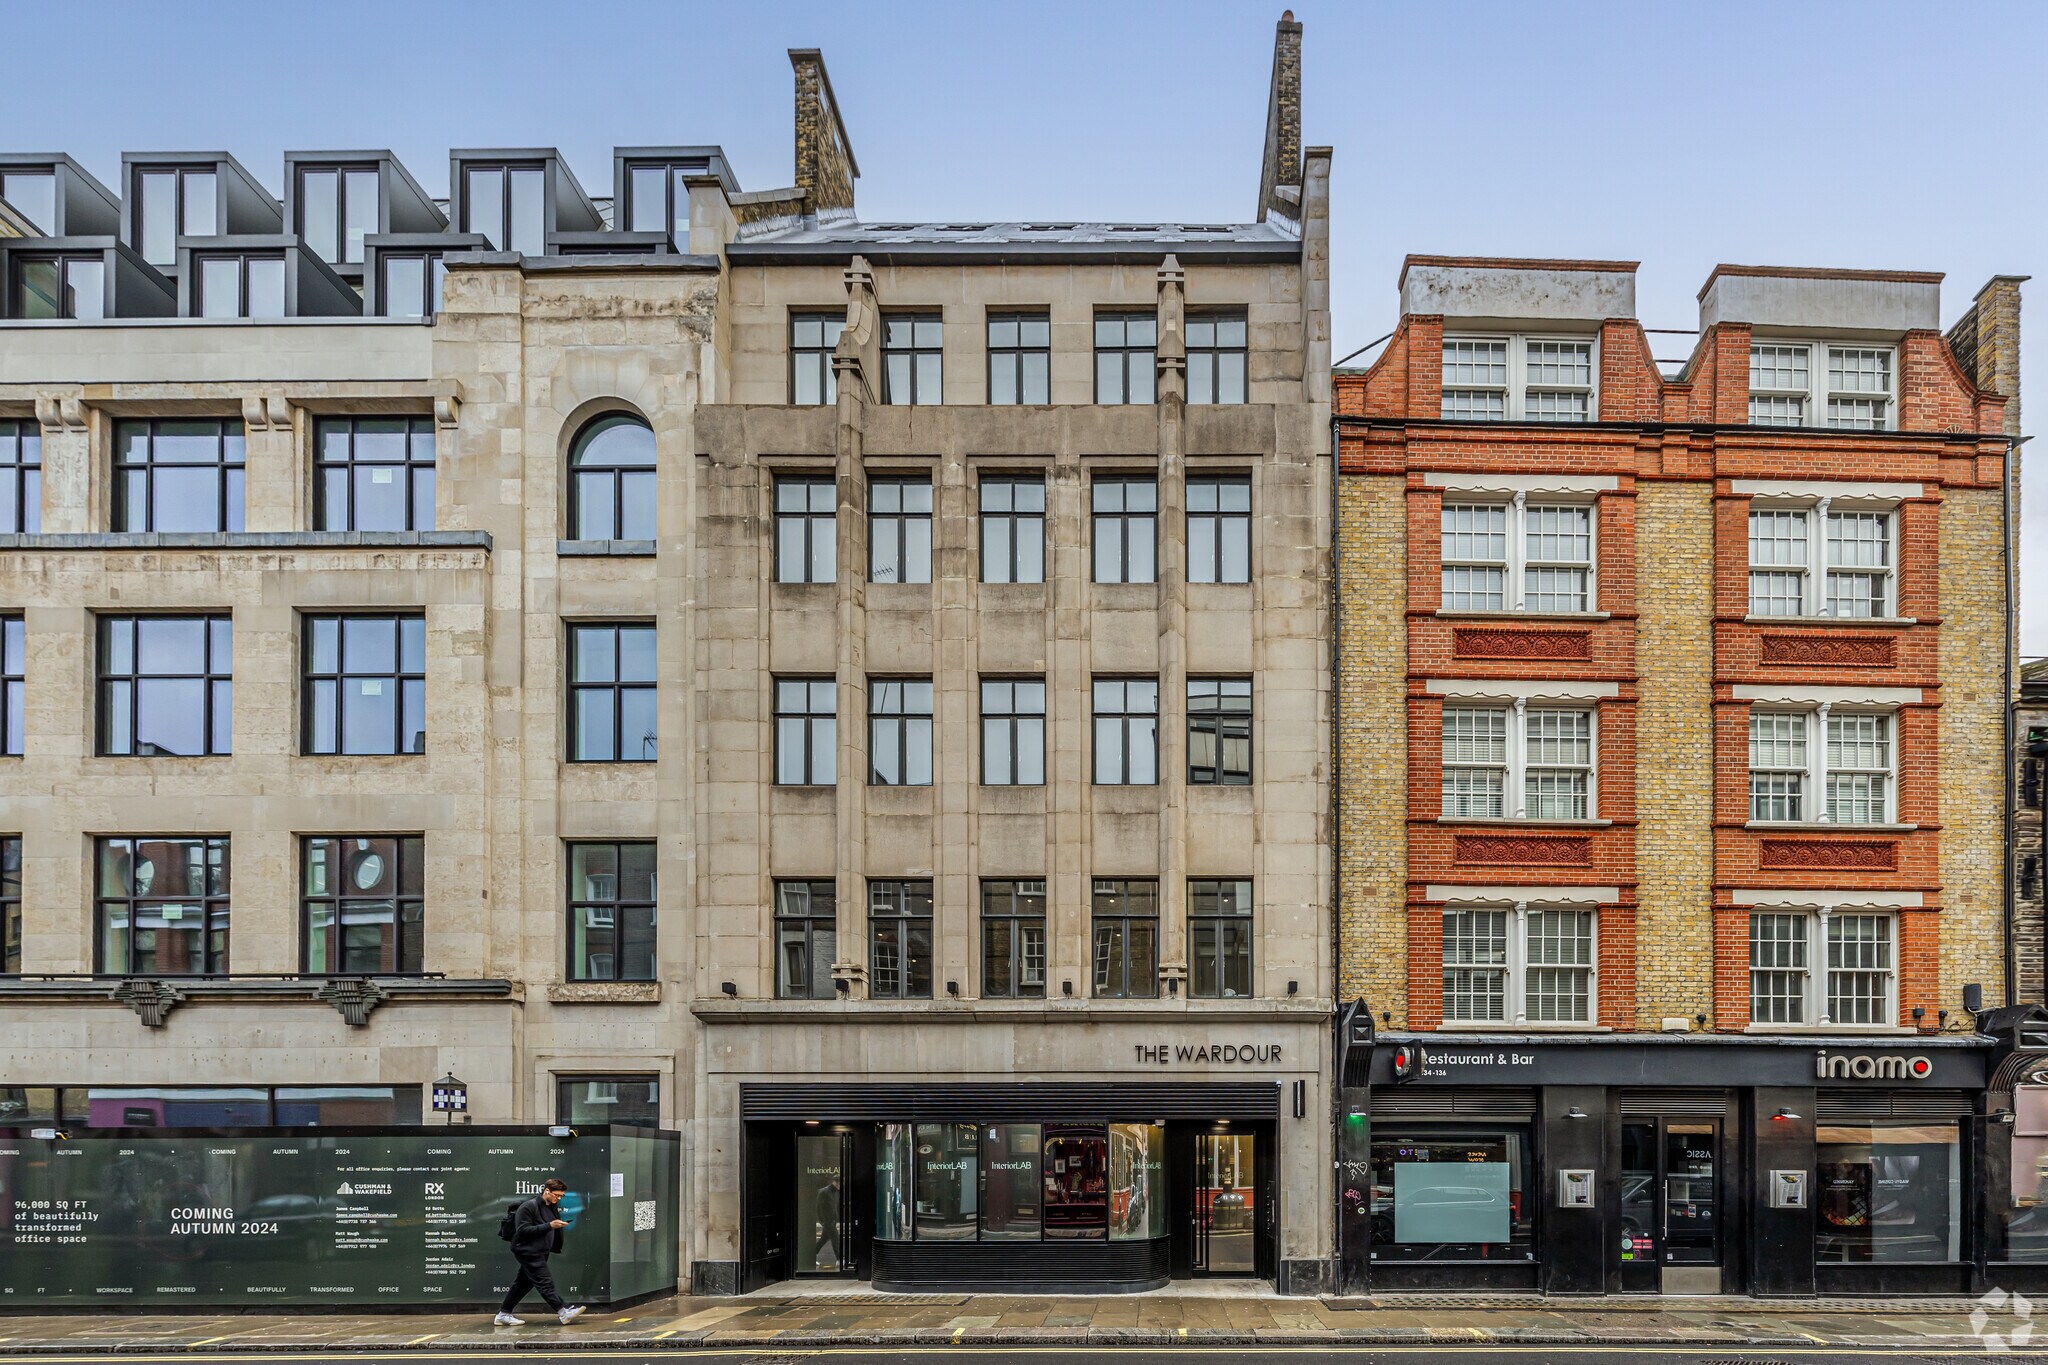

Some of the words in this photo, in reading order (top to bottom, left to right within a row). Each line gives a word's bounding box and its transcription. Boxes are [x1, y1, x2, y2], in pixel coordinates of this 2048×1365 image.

[1135, 1045, 1168, 1064] THE
[1176, 1045, 1281, 1064] WARDOUR
[1498, 1054, 1507, 1064] &
[1512, 1054, 1534, 1064] Bar
[1816, 1049, 1932, 1080] inamo
[927, 1161, 968, 1171] InteriorLAB
[991, 1161, 1032, 1170] InteriorLAB
[425, 1183, 444, 1194] RX
[516, 1181, 546, 1195] Hine
[15, 1201, 50, 1209] 96,000
[56, 1201, 68, 1209] SQ
[15, 1212, 26, 1220] of
[34, 1212, 98, 1221] beautifully
[171, 1208, 233, 1219] COMING
[15, 1223, 81, 1231] transformed
[171, 1223, 235, 1234] AUTUMN
[241, 1223, 278, 1234] 2024
